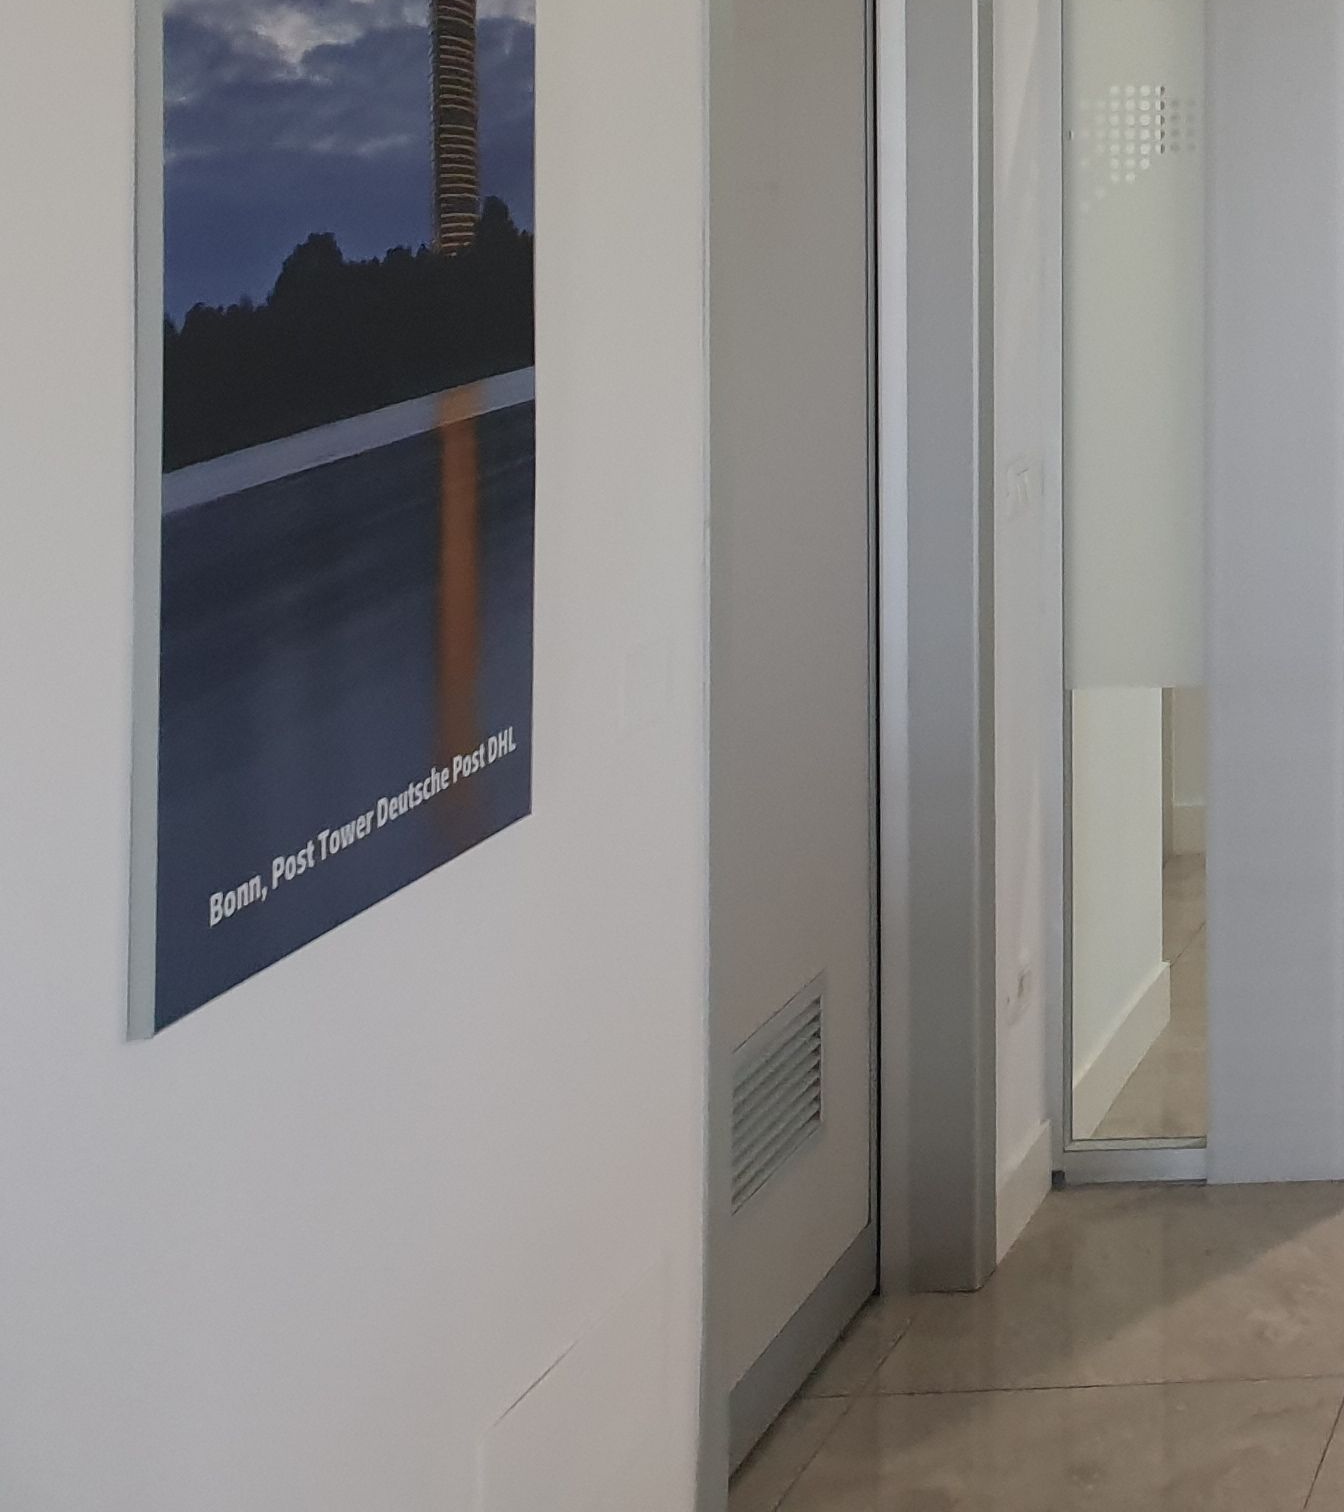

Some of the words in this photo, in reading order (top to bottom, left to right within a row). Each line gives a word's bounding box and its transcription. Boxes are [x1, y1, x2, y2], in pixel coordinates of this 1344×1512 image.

[208, 872, 269, 929] Bonn,
[271, 843, 316, 890] Post
[317, 808, 375, 862] Tower
[376, 764, 450, 830] Deutsche
[452, 742, 486, 784] Post
[487, 725, 518, 765] DHL
